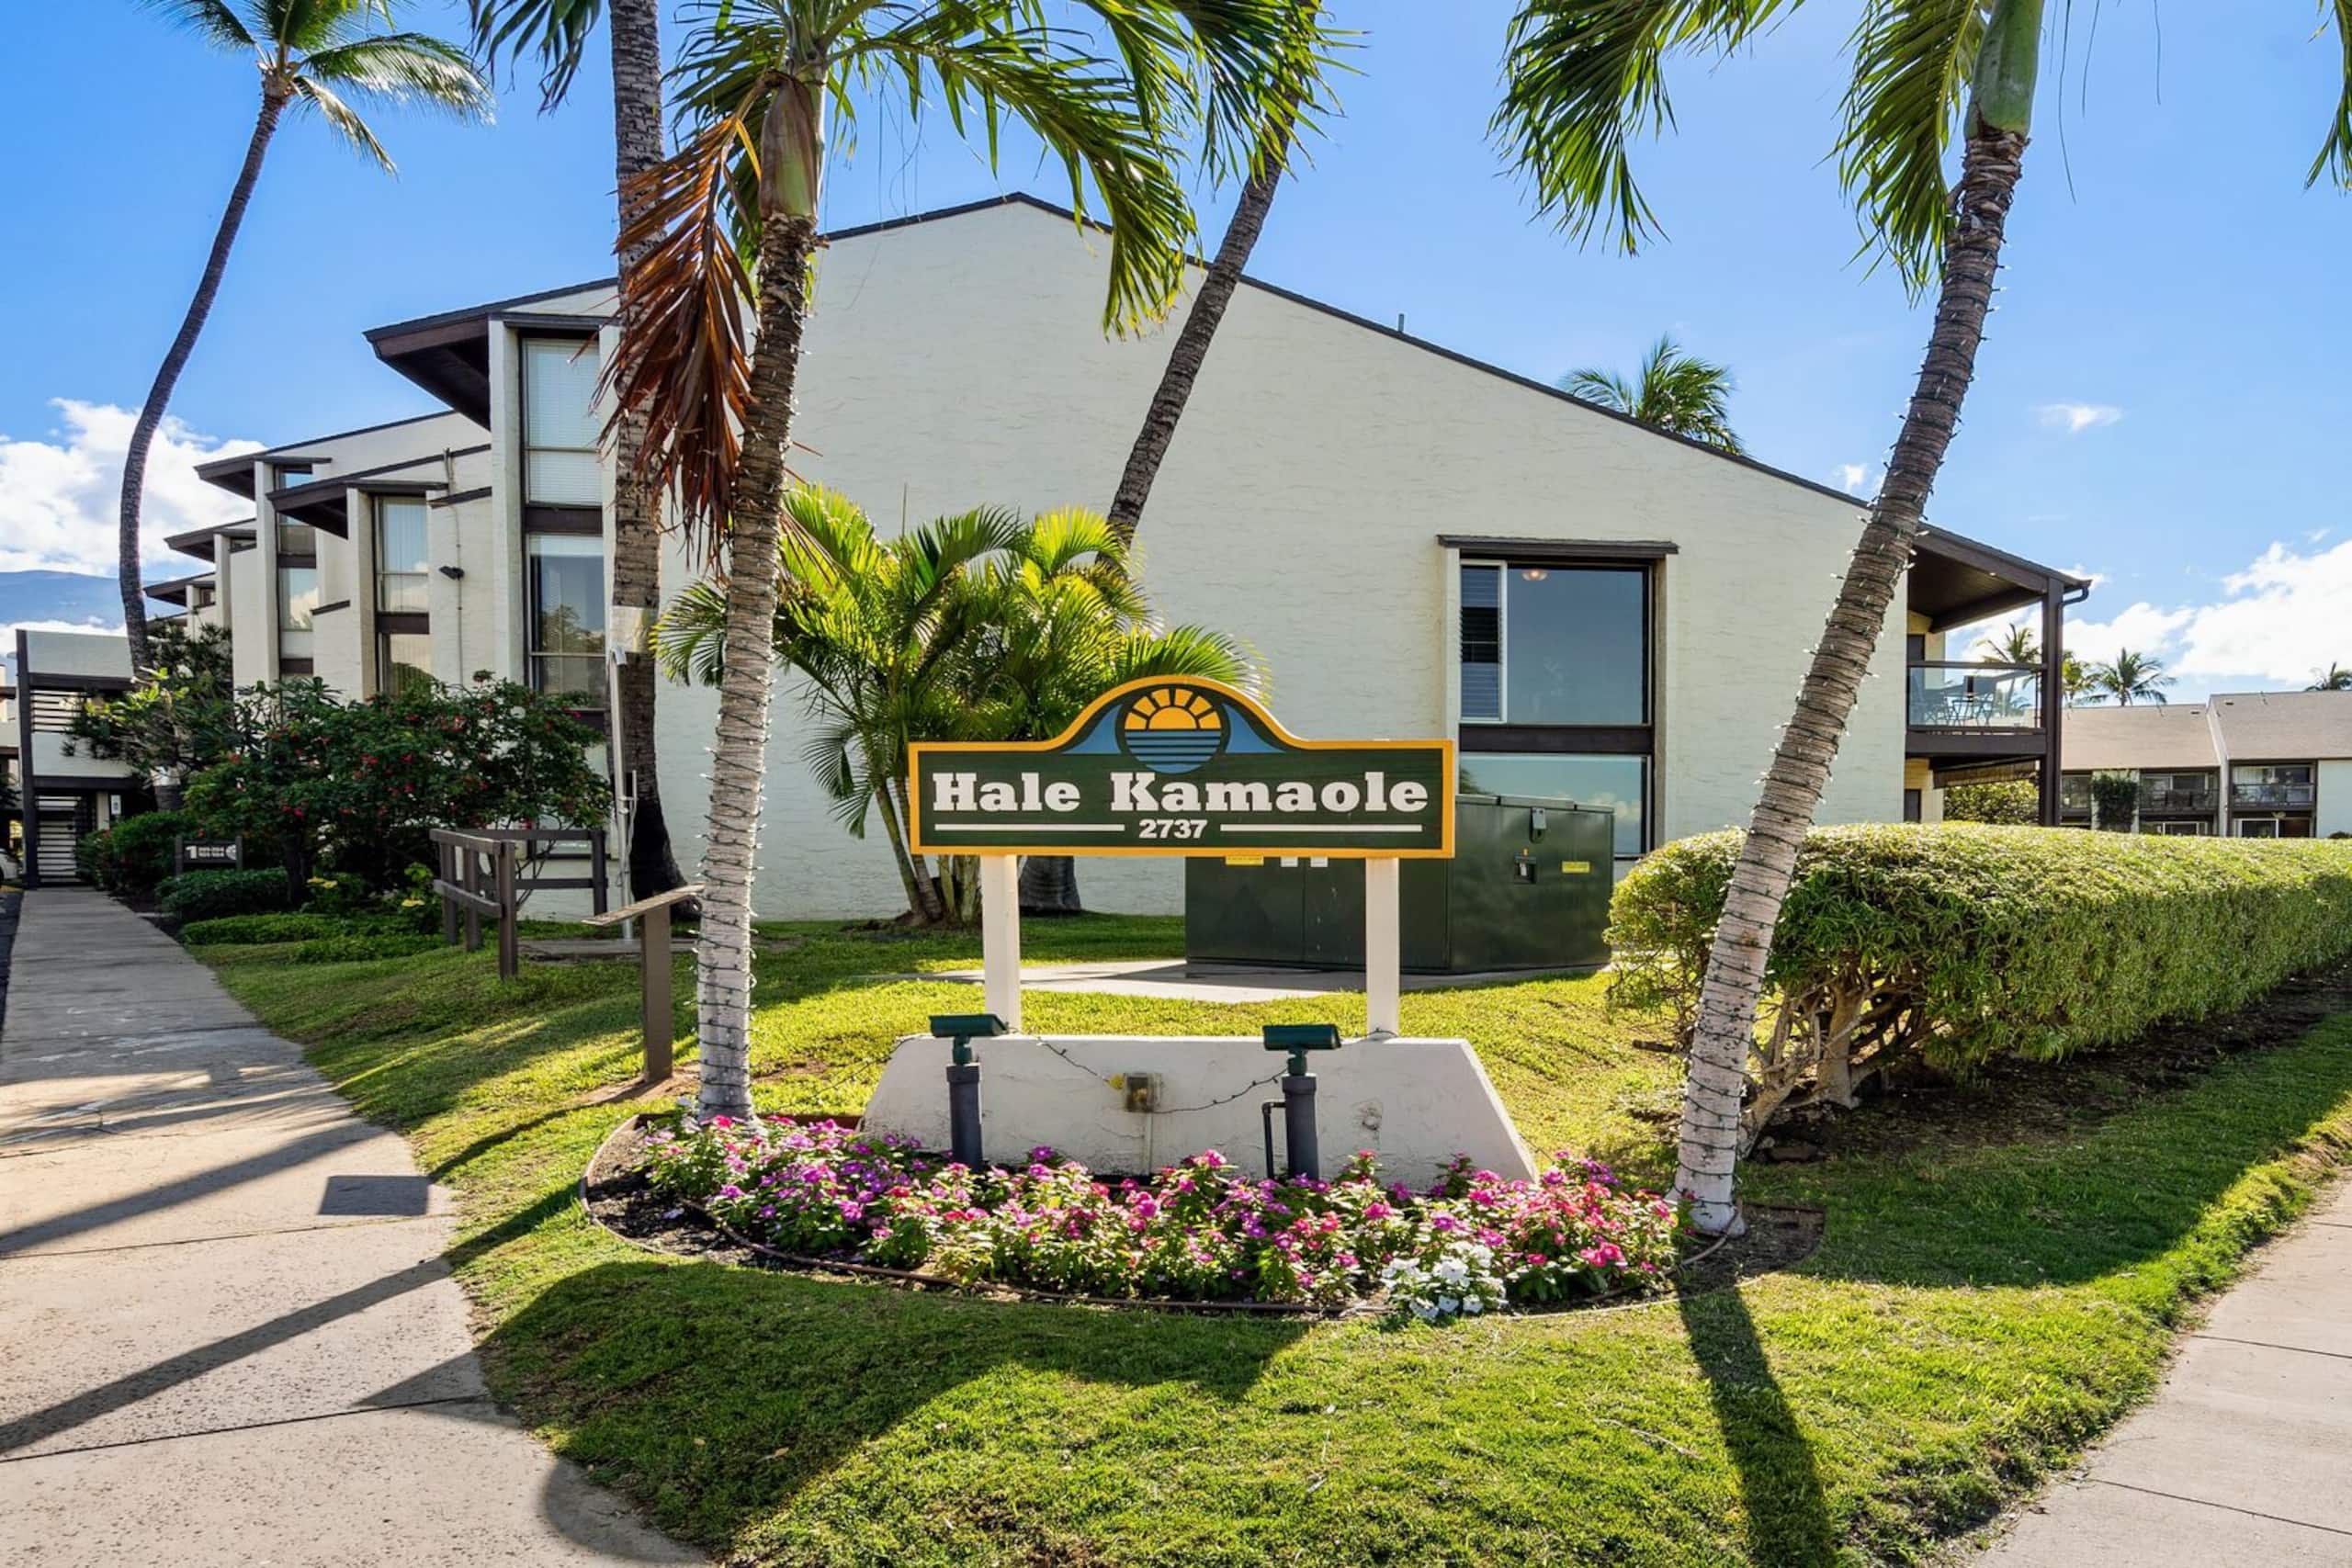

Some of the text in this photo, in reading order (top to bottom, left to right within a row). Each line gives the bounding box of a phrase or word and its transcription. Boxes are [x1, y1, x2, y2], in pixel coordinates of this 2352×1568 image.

[933, 773, 1429, 812] Hale Kamaole
[1138, 819, 1207, 840] 2737
